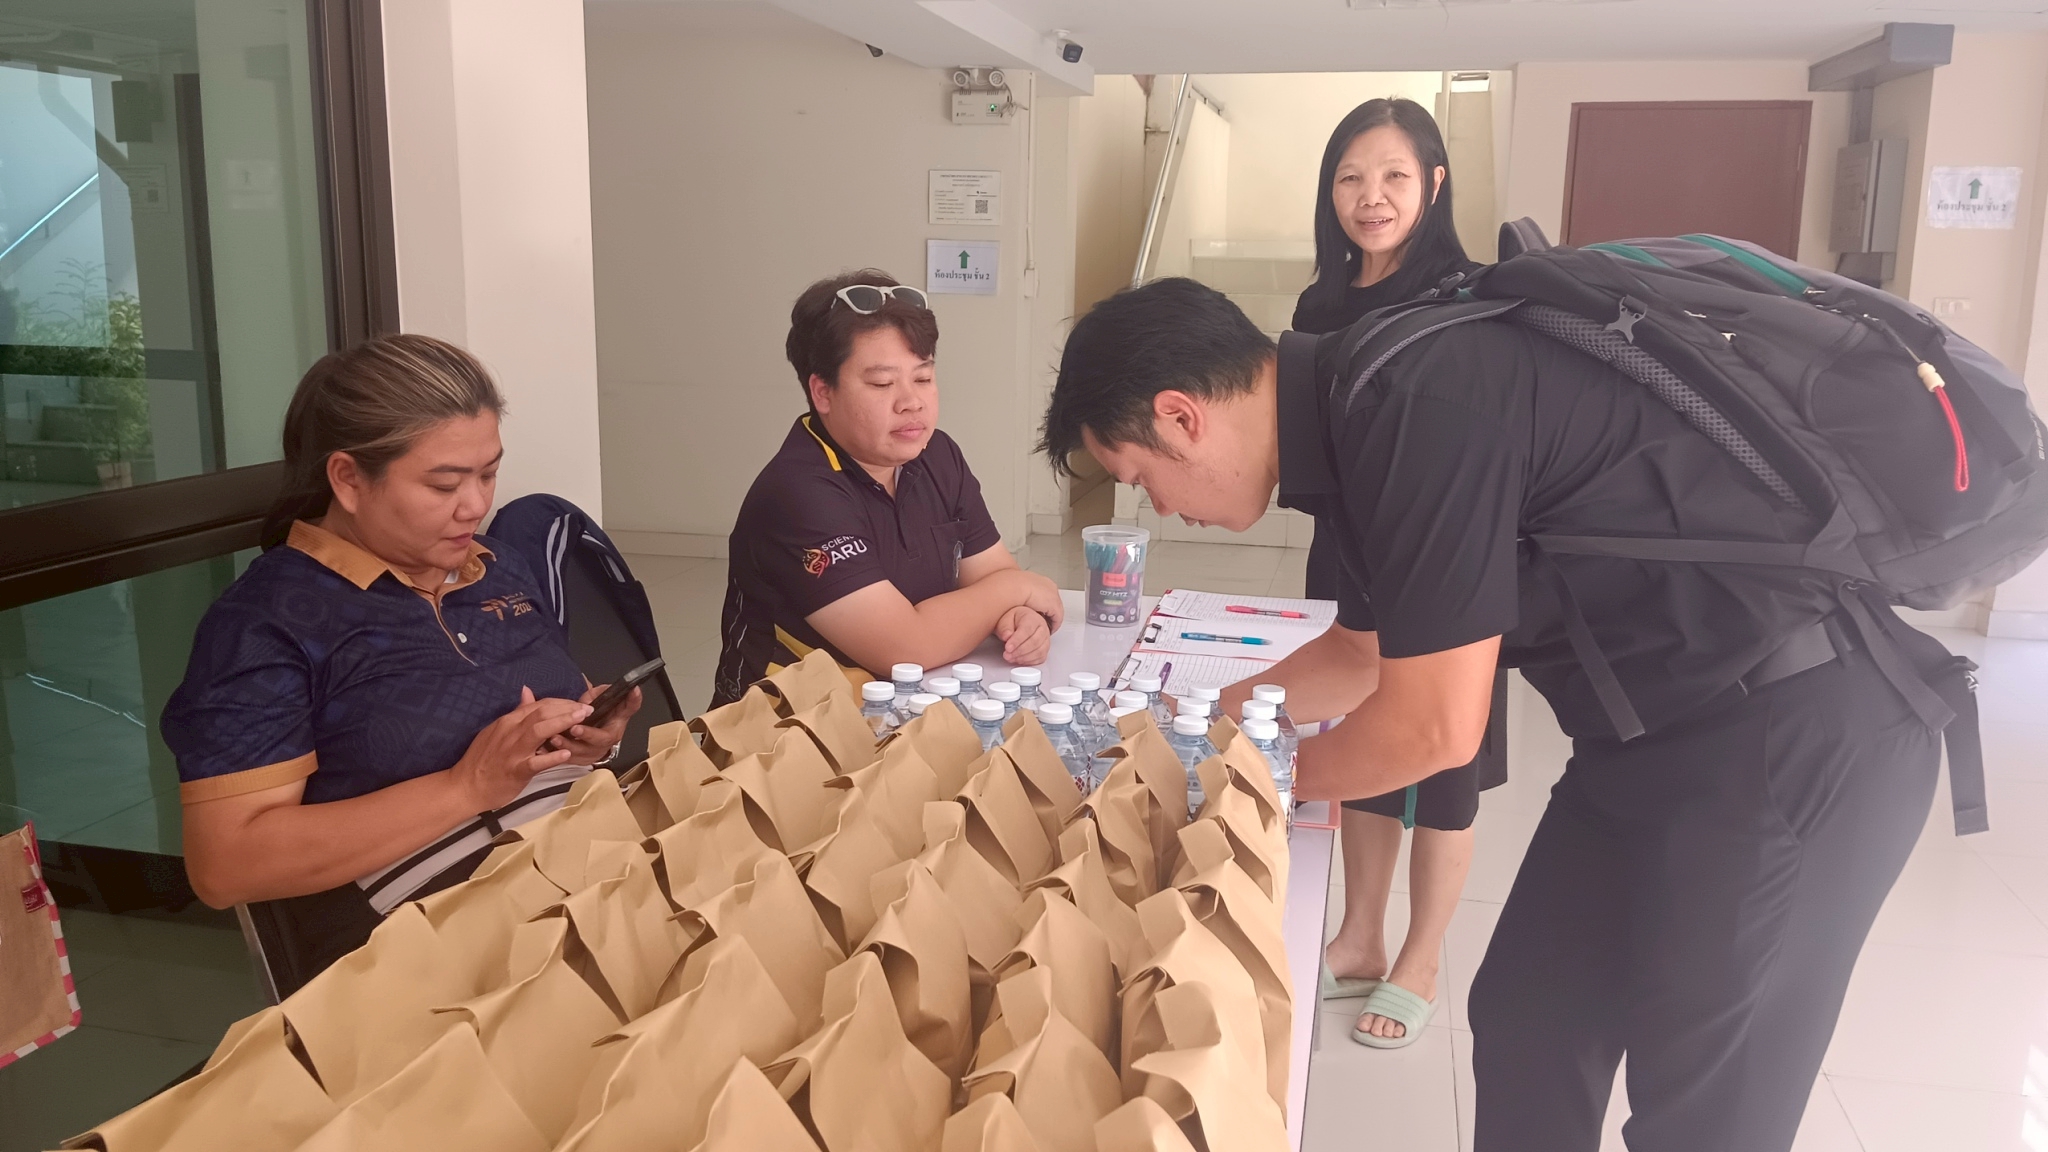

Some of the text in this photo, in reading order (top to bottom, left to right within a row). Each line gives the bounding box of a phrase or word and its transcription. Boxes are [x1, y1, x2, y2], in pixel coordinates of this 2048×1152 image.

[934, 269, 973, 282] ห้องประชุม
[974, 267, 985, 280] ชั้น
[830, 539, 868, 565] ARU
